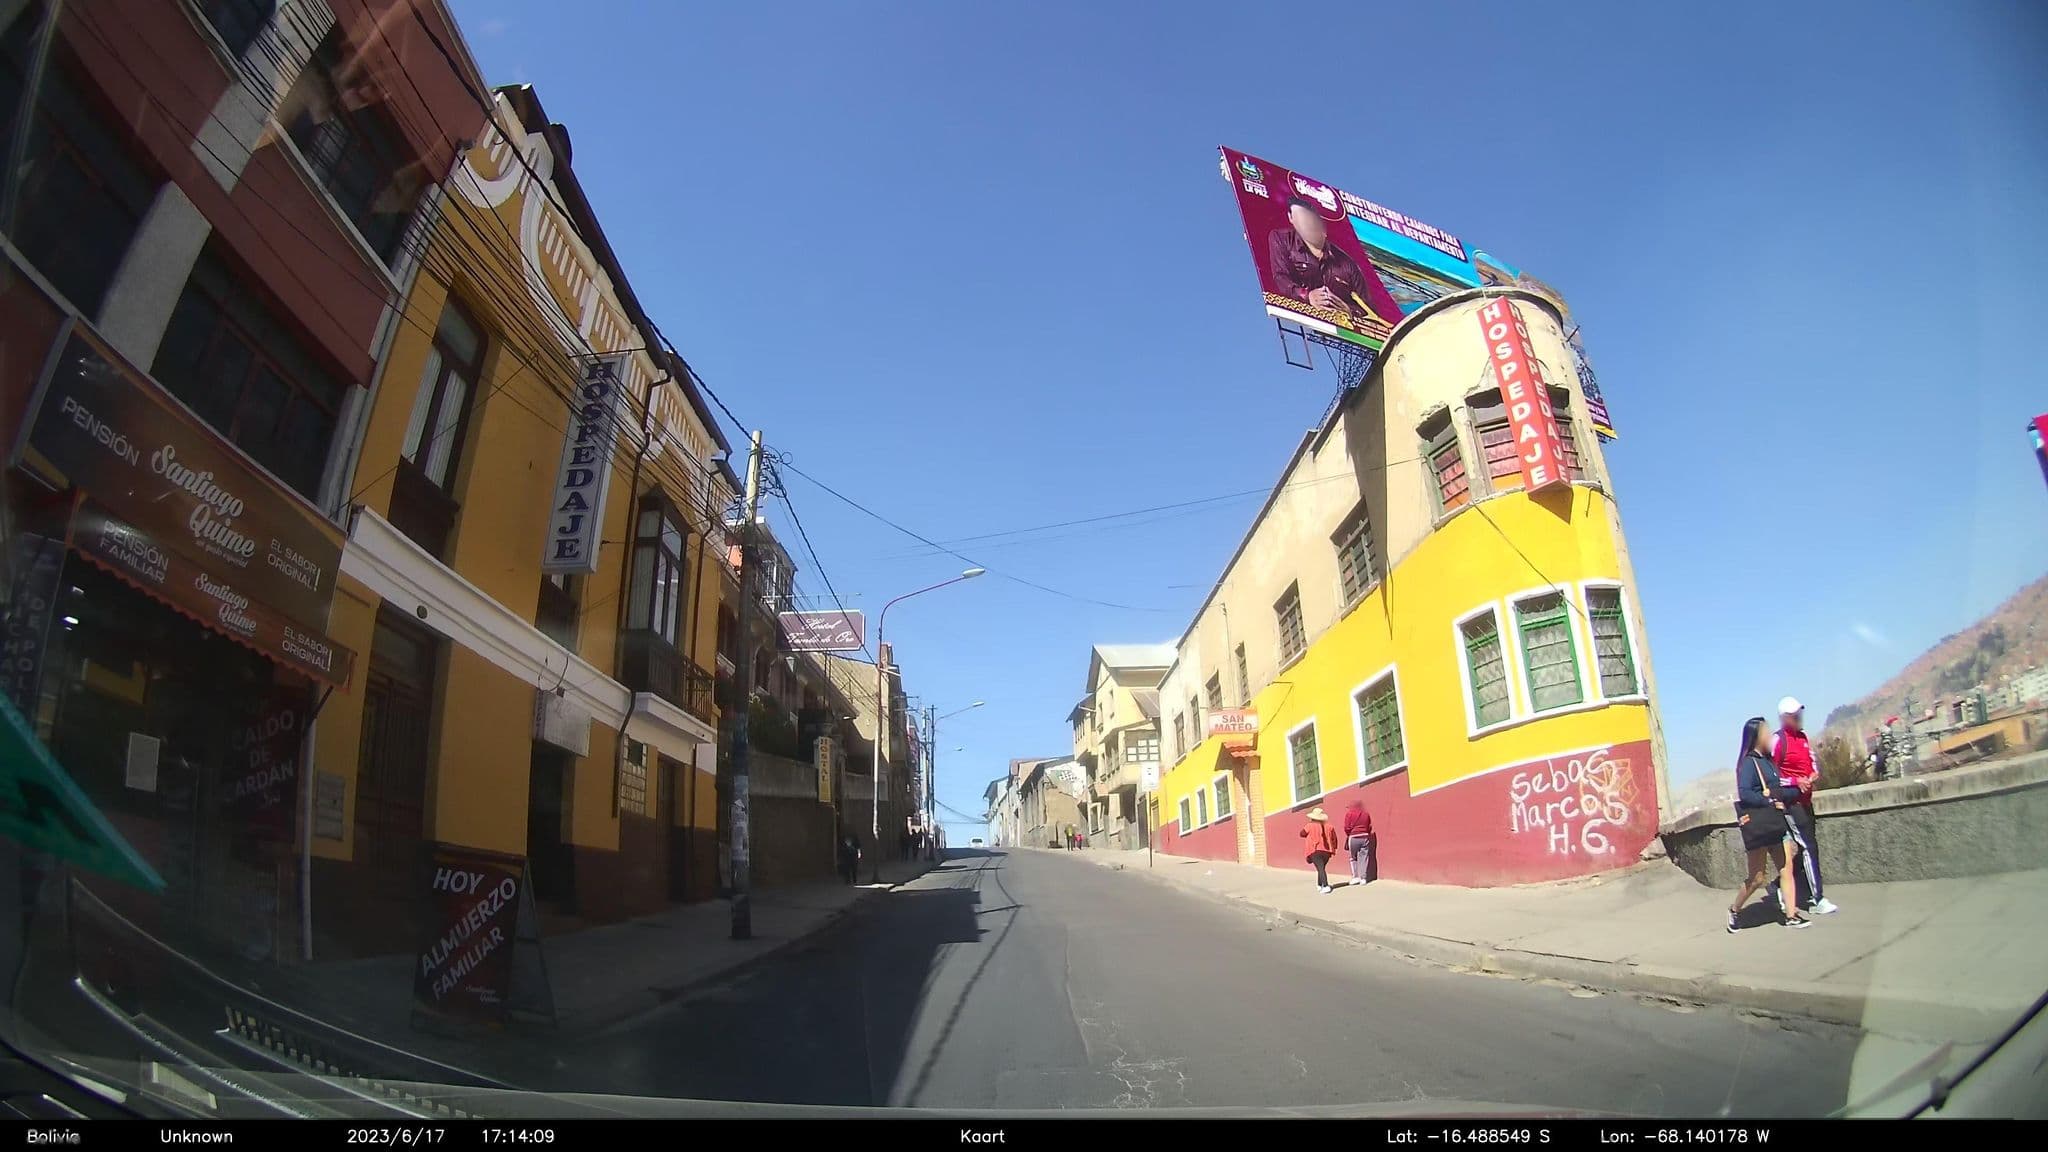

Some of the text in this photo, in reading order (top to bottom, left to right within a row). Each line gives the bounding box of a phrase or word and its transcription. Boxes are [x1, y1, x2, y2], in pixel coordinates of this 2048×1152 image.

[1338, 190, 1404, 224] CONSTRUYENDO
[1403, 215, 1440, 239] CAMINOS
[1438, 229, 1460, 248] PARA
[1344, 202, 1466, 260] INTEGRAR AL DEPARTAMENTO
[1482, 303, 1548, 486] HOSPEDAJE
[1510, 301, 1568, 484] HOSPEDAJE
[62, 396, 140, 467] PENSIÓN
[151, 444, 244, 518] Santiago
[553, 361, 615, 560] HOSPEDAJE
[103, 519, 170, 571] PENSIÓN
[189, 504, 257, 559] Quime
[271, 538, 318, 575] EL SABOR
[99, 536, 166, 584] FAMILIAR
[194, 572, 249, 609] Santiago
[218, 602, 257, 632] Quime
[283, 625, 330, 656] EL SABOR
[1214, 723, 1253, 732] MATEO
[1222, 714, 1245, 723] SAN
[819, 738, 829, 783] HOSTAL
[432, 867, 486, 895] HOY
[421, 877, 518, 978] ALMUERZO
[432, 926, 506, 1001] FAMILIAR
